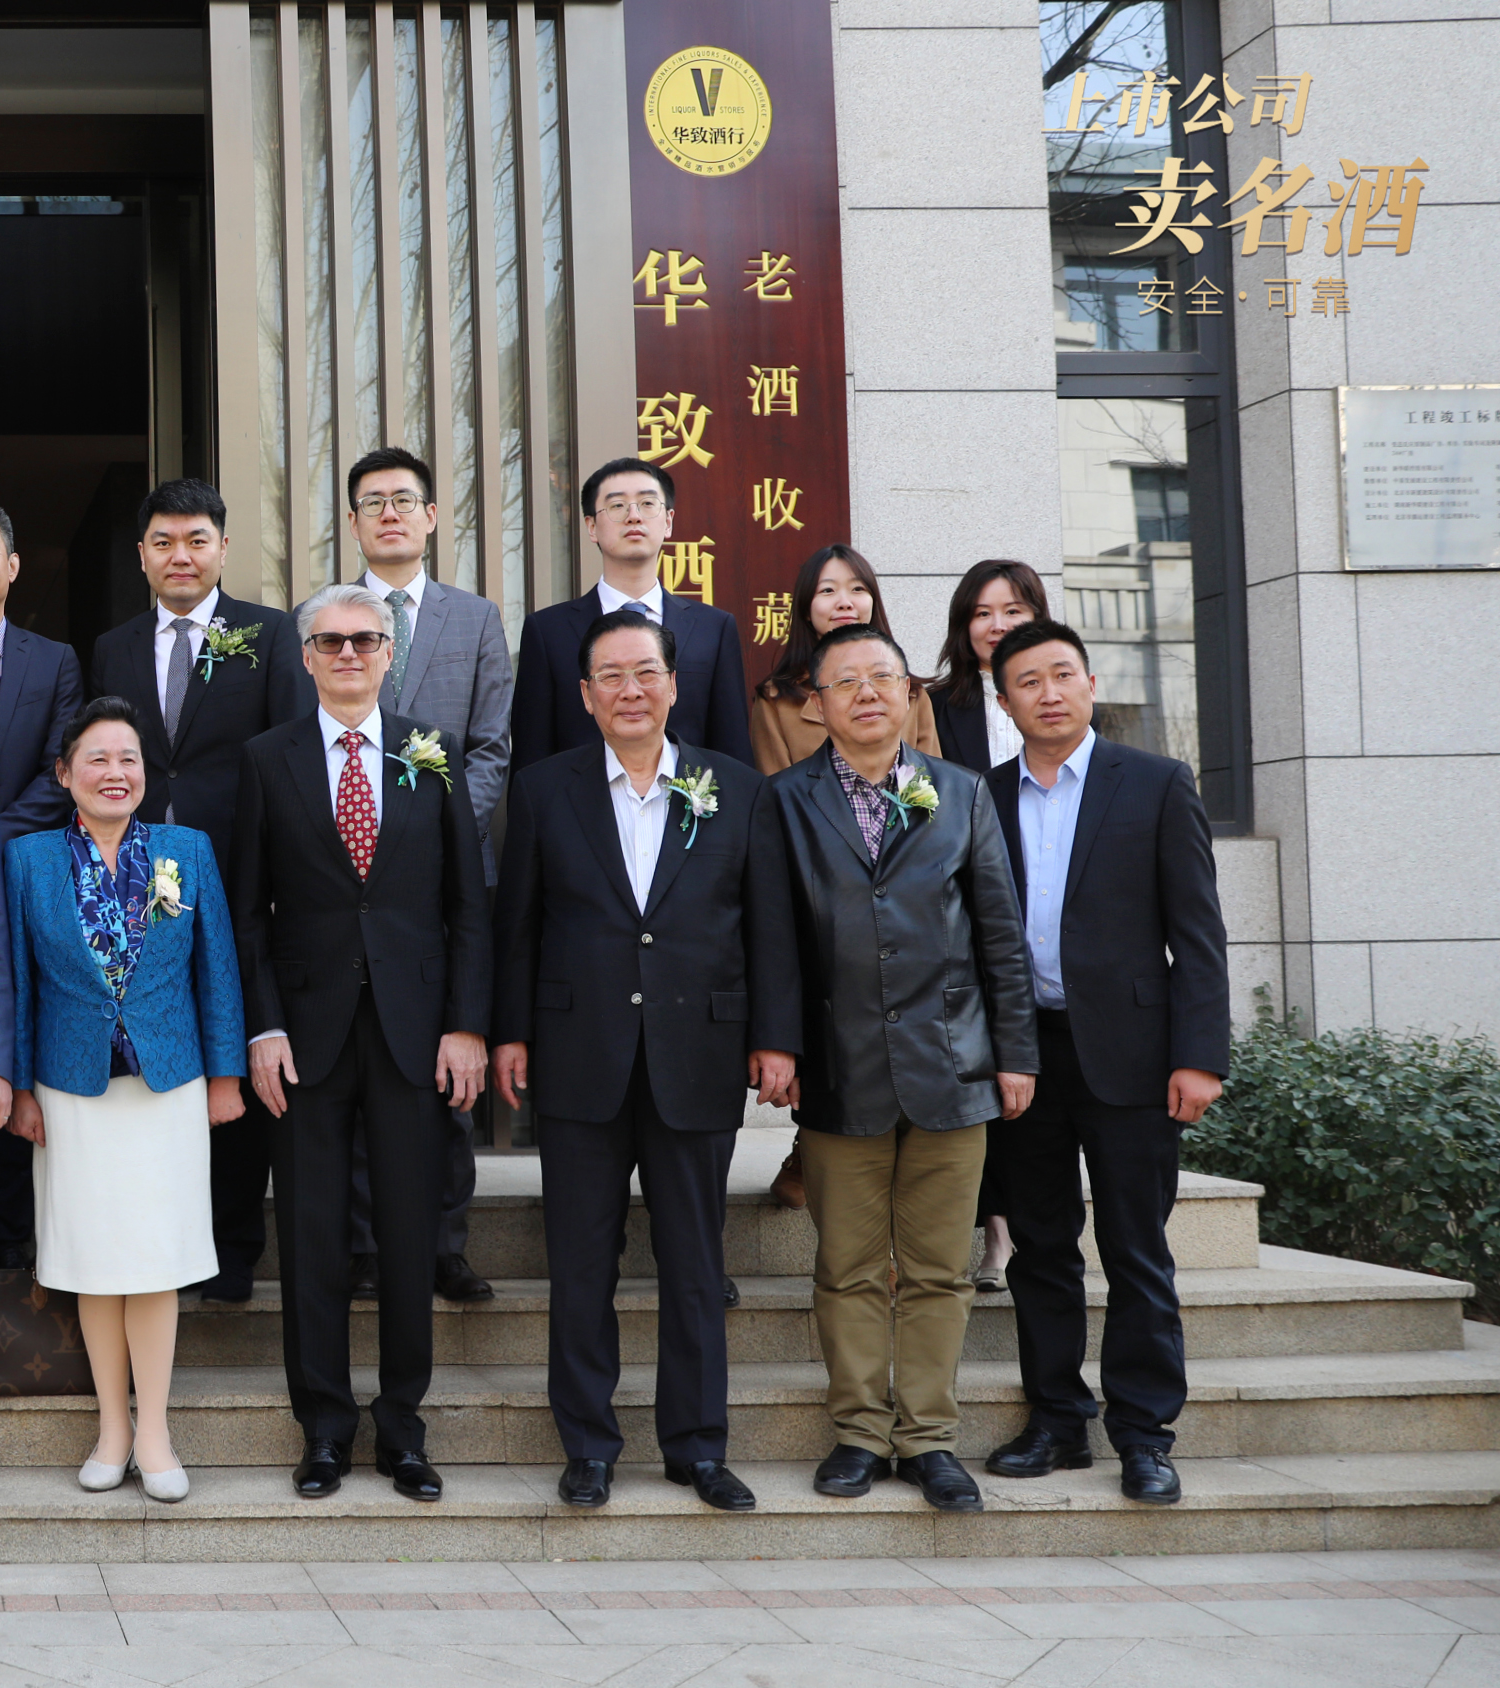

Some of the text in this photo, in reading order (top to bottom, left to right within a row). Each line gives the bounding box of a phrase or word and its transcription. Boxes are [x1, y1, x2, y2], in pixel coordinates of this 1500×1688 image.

[673, 54, 688, 65] FINE
[690, 50, 720, 58] LIQUORS
[722, 54, 743, 69] SALES
[671, 105, 745, 115] LIQUOR STORES
[671, 126, 745, 145] 华致酒行
[743, 251, 805, 646] 老酒收藏
